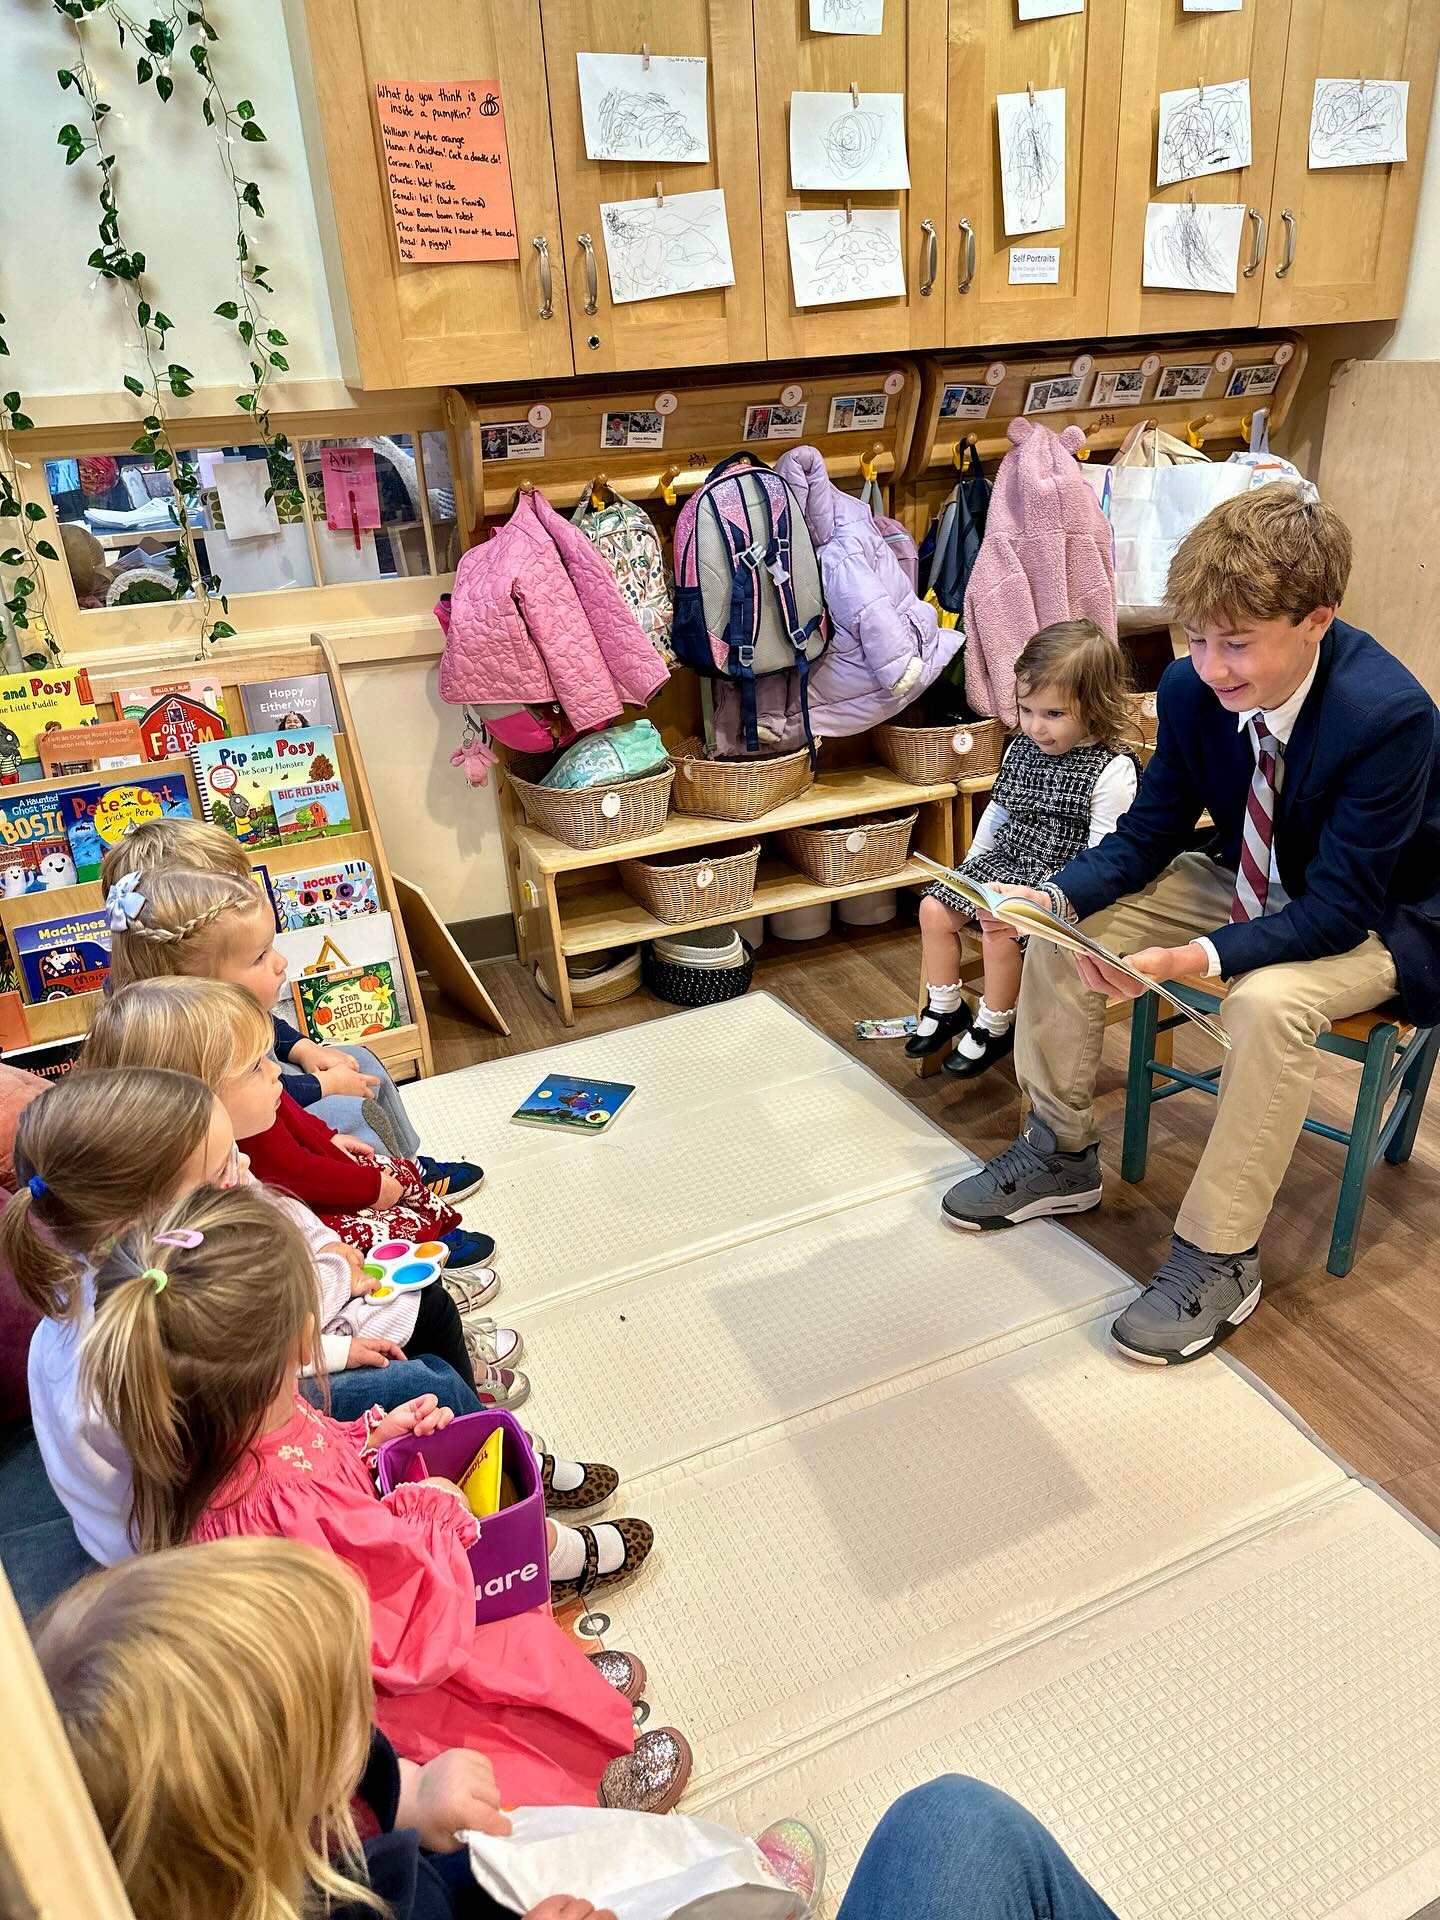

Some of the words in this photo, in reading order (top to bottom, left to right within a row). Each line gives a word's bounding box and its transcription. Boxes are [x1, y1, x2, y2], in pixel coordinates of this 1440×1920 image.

[377, 84, 401, 99] What
[405, 89, 414, 102] do
[419, 93, 434, 106] you
[439, 88, 462, 102] think
[468, 90, 476, 101] is
[390, 102, 414, 117] inside
[432, 107, 471, 121] pumpkin?
[414, 130, 438, 144] Maybe
[441, 135, 465, 149] orange
[409, 144, 415, 152] A
[470, 152, 489, 163] doodle
[415, 160, 433, 172] Pink!
[435, 180, 456, 191] inside
[416, 208, 434, 218] Boom
[436, 210, 453, 220] boom
[456, 212, 474, 221] robot
[396, 222, 416, 232] Theo:
[416, 224, 440, 234] Rainbow
[441, 226, 453, 235] like
[481, 228, 493, 237] the
[495, 228, 515, 237] beach
[421, 238, 427, 247] A
[1013, 254, 1026, 263] Self
[1026, 254, 1056, 263] Portraits
[2, 686, 27, 700] and
[30, 678, 71, 697] Posy
[268, 688, 304, 699] Happy
[10, 702, 31, 713] Little
[32, 700, 58, 710] Puddle
[260, 702, 292, 713] Either
[294, 698, 317, 708] Way
[162, 724, 177, 735] ON
[179, 720, 198, 734] THE
[86, 739, 108, 747] Nursery
[219, 748, 247, 767] Pip
[252, 747, 273, 761] and
[276, 739, 315, 757] Posy
[236, 768, 251, 777] The
[252, 766, 274, 776] Scary
[275, 761, 304, 771] Monster
[278, 790, 294, 800] BIG
[296, 787, 313, 798] RED
[314, 782, 340, 794] BARN
[26, 794, 59, 806] Haunted
[72, 796, 119, 819] Pete
[120, 790, 134, 801] the
[136, 784, 173, 806] Cat
[12, 804, 39, 816] Ghost
[40, 803, 58, 812] Tour
[104, 812, 125, 825] Trick
[135, 808, 154, 817] Pete
[303, 874, 344, 890] HOCKEY
[38, 920, 106, 940] Machines
[75, 929, 112, 941] Farm
[73, 972, 107, 986] Mais
[338, 994, 360, 1004] From
[334, 1002, 363, 1020] SEED
[364, 1003, 373, 1011] to
[326, 1012, 385, 1038] PUMPKIN
